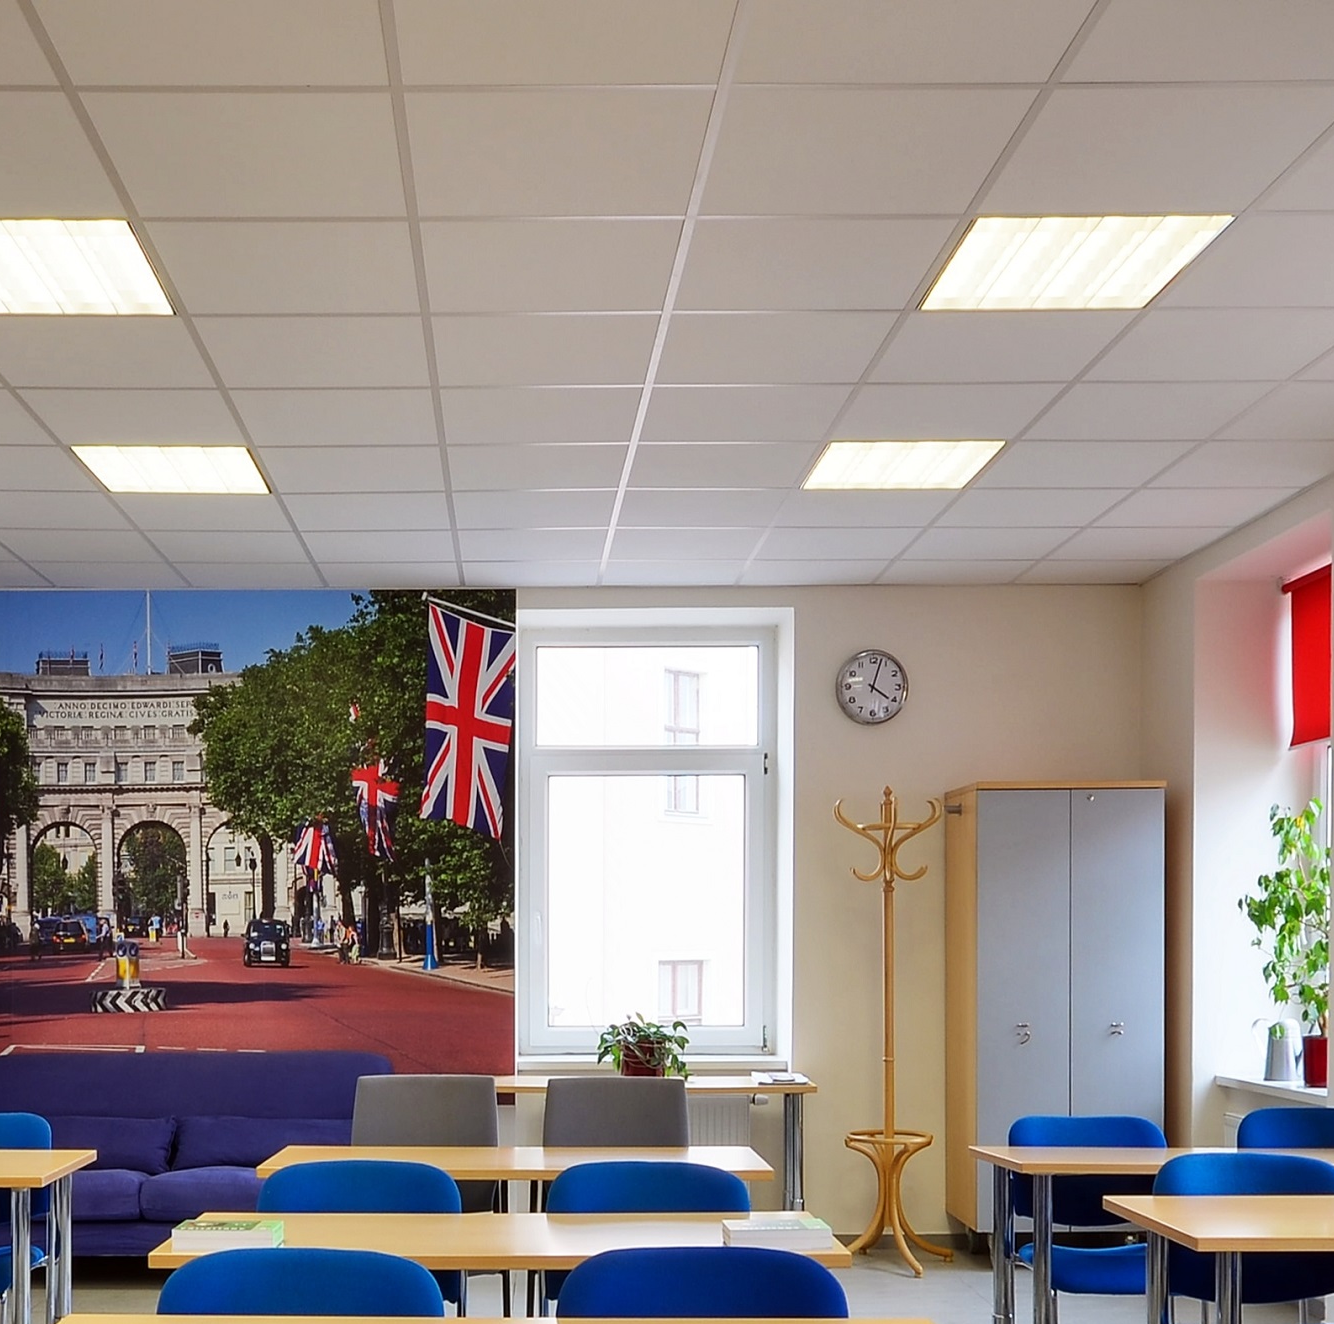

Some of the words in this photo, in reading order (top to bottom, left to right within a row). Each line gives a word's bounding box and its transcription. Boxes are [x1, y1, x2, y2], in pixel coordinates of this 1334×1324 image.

[844, 683, 852, 691] 9
[894, 683, 901, 691] 3
[131, 701, 172, 709] EDWARDI
[129, 710, 157, 718] CIVES
